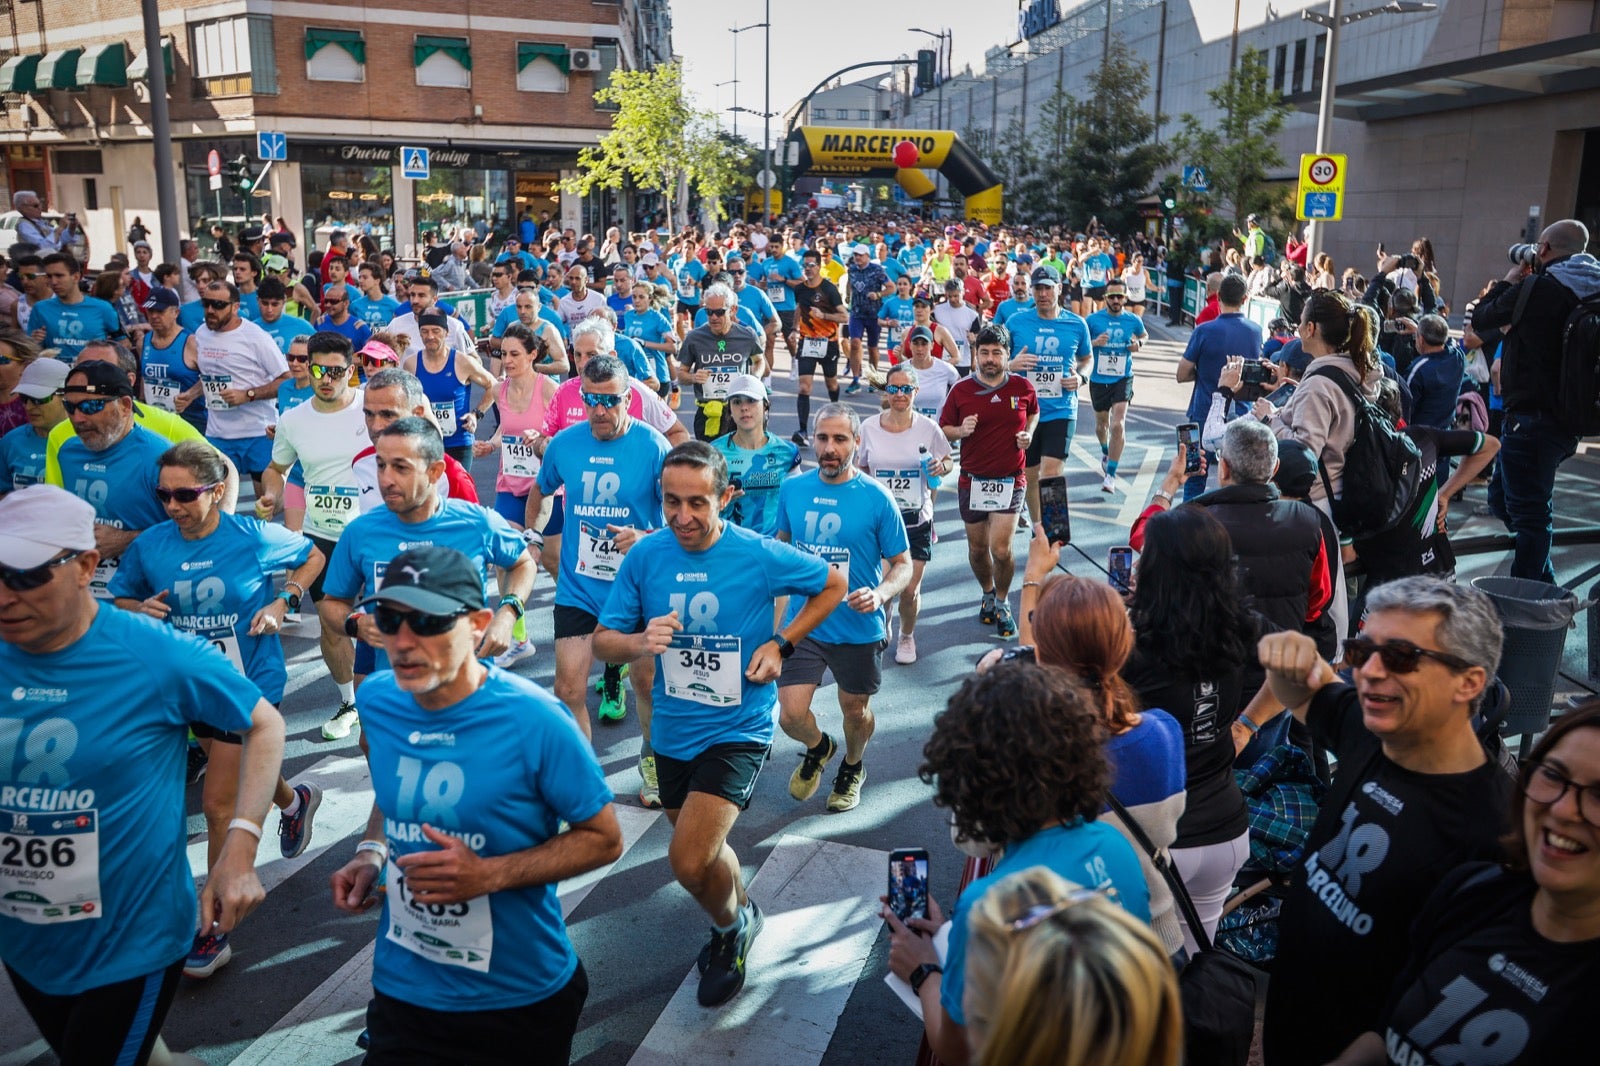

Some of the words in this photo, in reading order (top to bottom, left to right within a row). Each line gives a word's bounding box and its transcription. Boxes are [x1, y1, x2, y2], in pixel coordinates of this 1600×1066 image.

[342, 145, 391, 160] Puerta
[1314, 166, 1331, 176] 30
[1035, 336, 1060, 355] 18
[701, 352, 743, 364] UAPO
[711, 373, 731, 383] 762
[1035, 372, 1056, 383] 290
[151, 385, 171, 397] 178
[432, 410, 450, 419] 66
[566, 407, 583, 417] ABB
[506, 444, 533, 457] 1419
[581, 470, 620, 506] 18
[887, 478, 910, 489] 122
[981, 482, 1004, 493] 230
[314, 495, 353, 510] 2079
[573, 504, 630, 518] MARCELINO
[804, 511, 841, 545] 18
[174, 576, 226, 616] 18
[669, 591, 720, 634] 18
[171, 613, 238, 629] MARCELINO
[680, 650, 721, 671] 345
[693, 669, 710, 678] JESUS
[27, 687, 68, 697] OXIMESA
[396, 755, 465, 829] 18
[1, 836, 76, 868] 266
[1320, 801, 1390, 898] 18
[430, 917, 461, 928] MARIA
[1407, 974, 1530, 1066] 18
